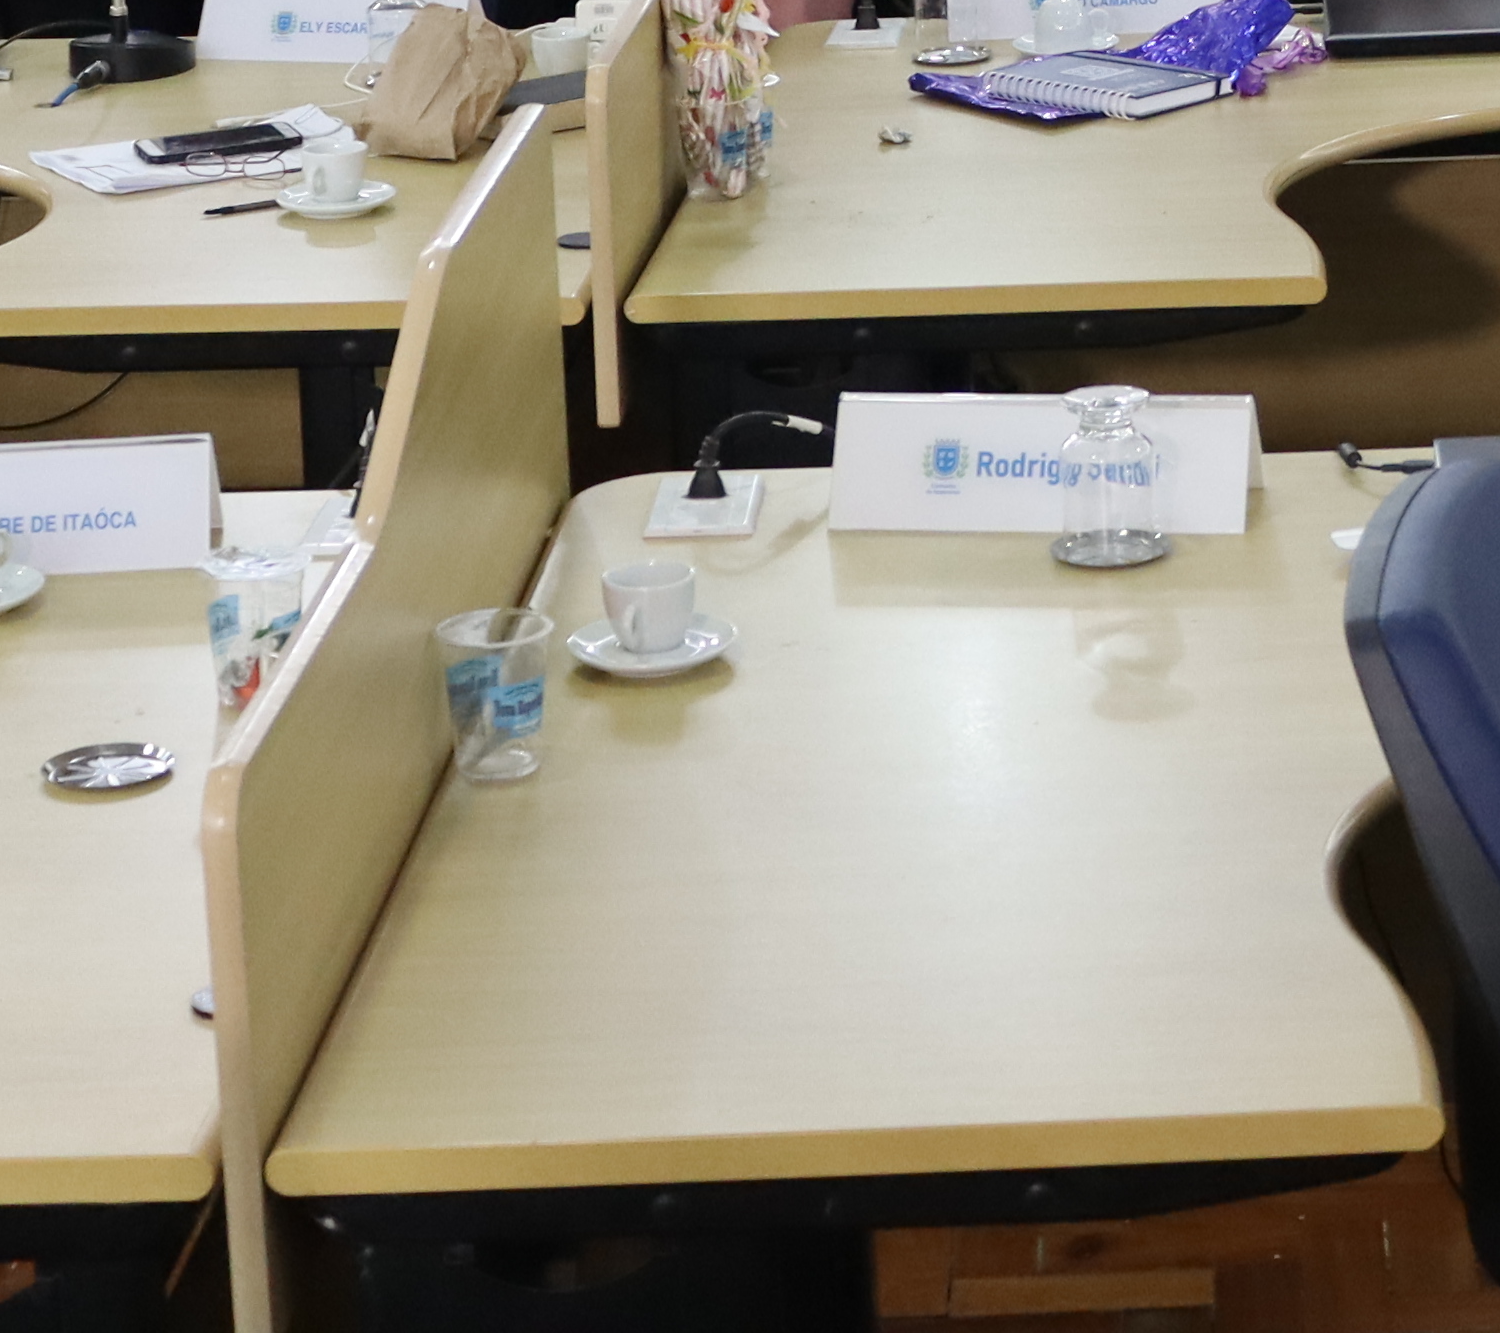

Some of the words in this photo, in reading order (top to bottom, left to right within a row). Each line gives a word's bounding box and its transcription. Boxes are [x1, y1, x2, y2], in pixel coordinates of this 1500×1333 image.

[300, 21, 324, 33] ELY
[326, 21, 368, 34] ESCAR
[976, 450, 1062, 485] Rodrig
[30, 514, 57, 534] DE
[62, 506, 137, 533] ITAÓCA
